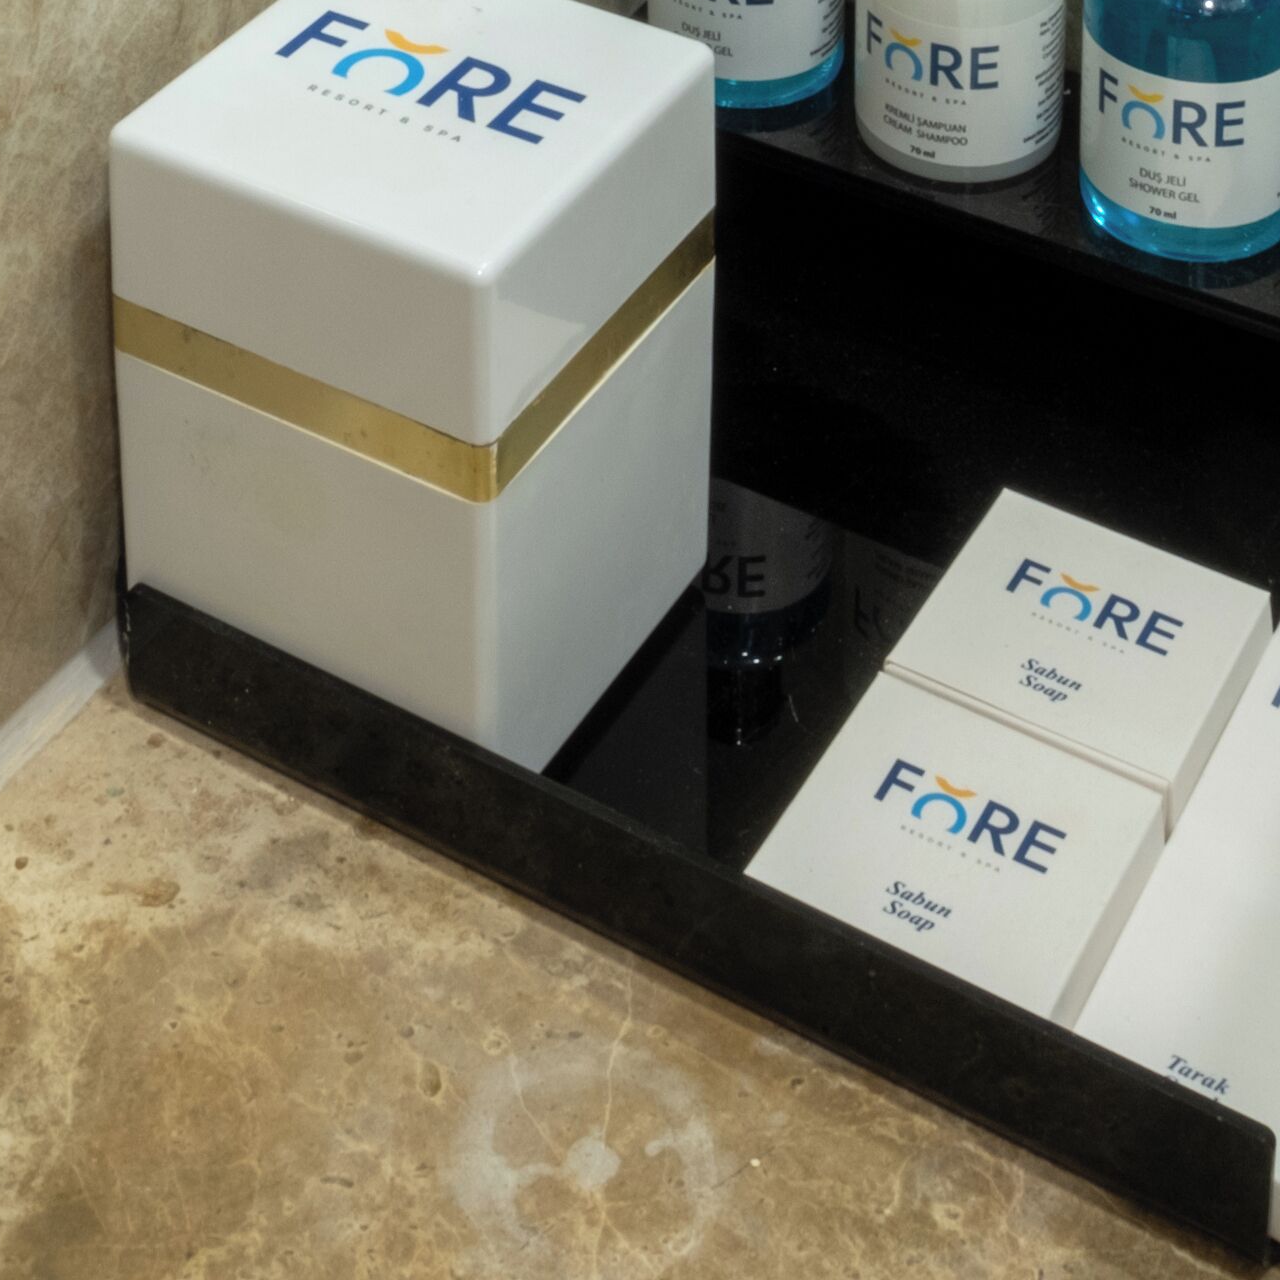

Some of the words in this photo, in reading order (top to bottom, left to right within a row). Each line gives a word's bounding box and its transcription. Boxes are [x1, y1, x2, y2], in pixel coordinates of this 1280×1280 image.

[866, 10, 1000, 91] FORE
[274, 9, 588, 145] FORE
[306, 83, 389, 117] RESORT
[399, 115, 411, 125] &
[423, 124, 463, 144] SPA
[1097, 66, 1246, 149] FORE
[916, 128, 968, 146] SHAMPOO
[1128, 176, 1176, 200] SHOWER
[1178, 191, 1200, 204] GEL
[1138, 167, 1163, 184] DUŞ
[1148, 206, 1162, 218] 70
[1163, 210, 1177, 220] ml
[1005, 558, 1185, 657] FORE
[1018, 674, 1069, 703] Soap
[1020, 657, 1083, 692] Sabun
[873, 758, 1067, 875] FORE
[882, 899, 936, 932] Soap
[884, 880, 953, 919] Sabun
[1166, 1054, 1230, 1095] Tarak
